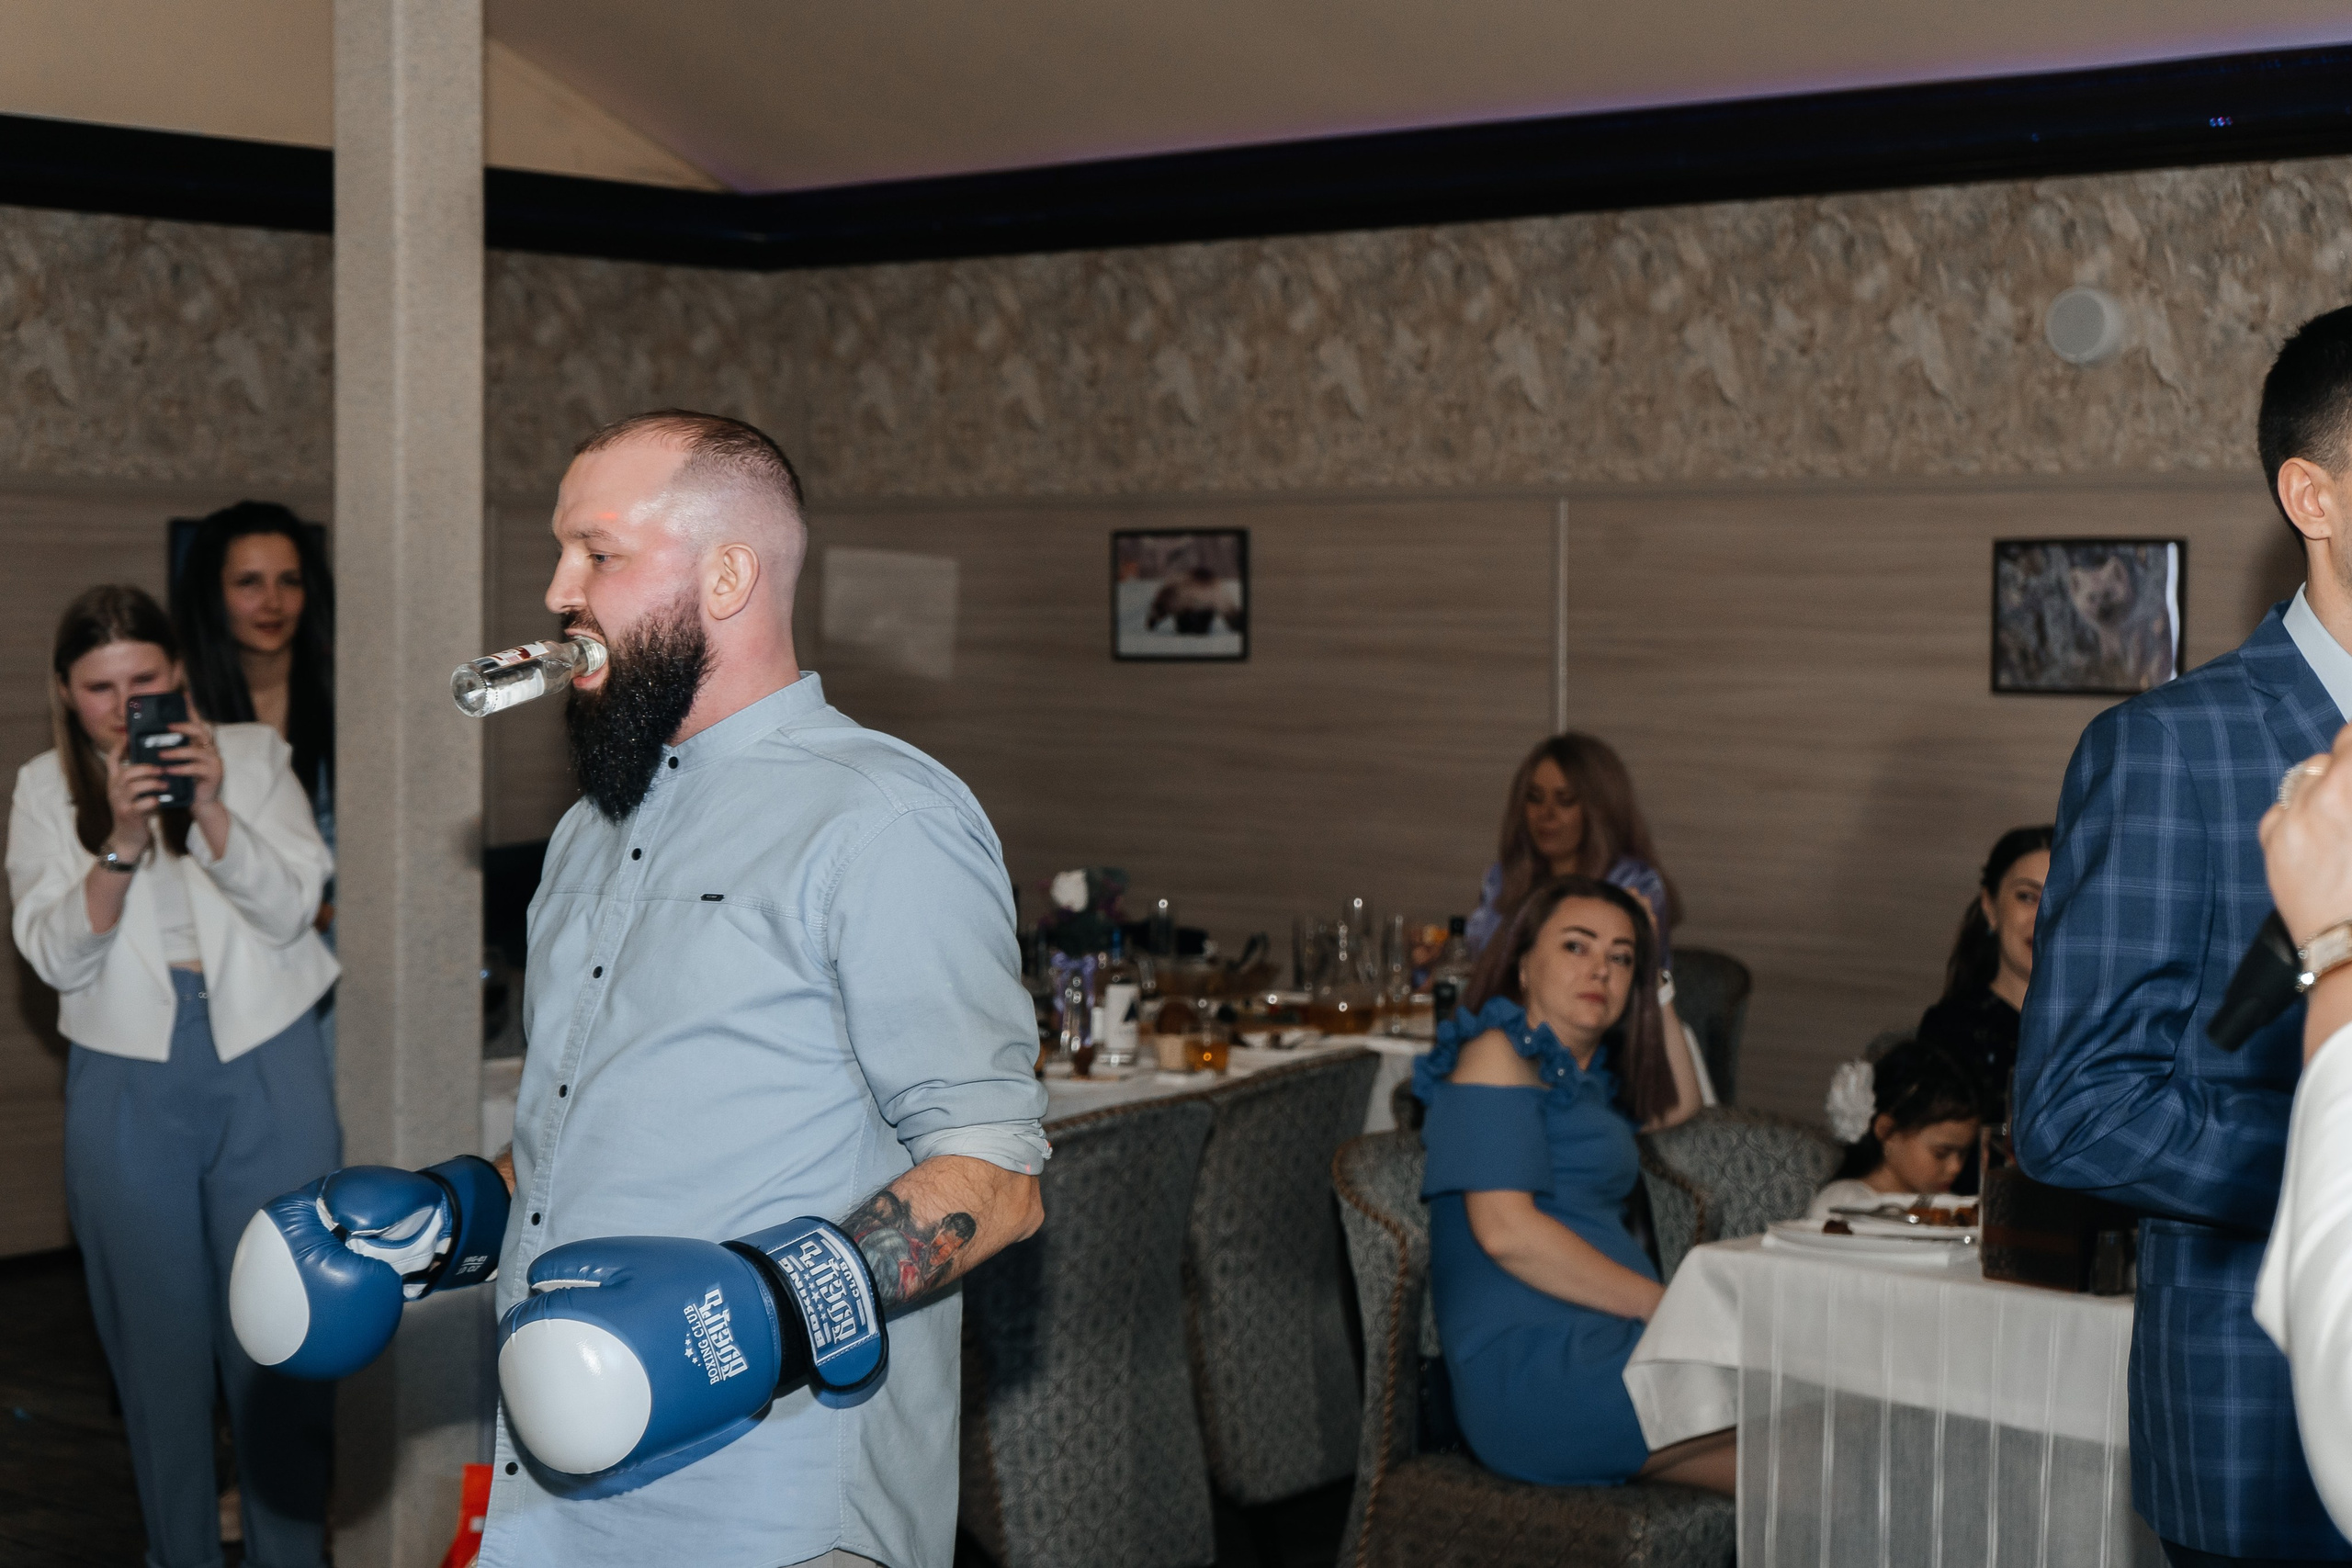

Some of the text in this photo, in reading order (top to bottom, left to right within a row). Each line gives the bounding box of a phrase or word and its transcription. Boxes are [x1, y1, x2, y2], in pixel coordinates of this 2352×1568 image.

[778, 1257, 827, 1348] BOXING
[840, 1261, 861, 1298] CLUB
[683, 1305, 720, 1385] BOXING CLUB
